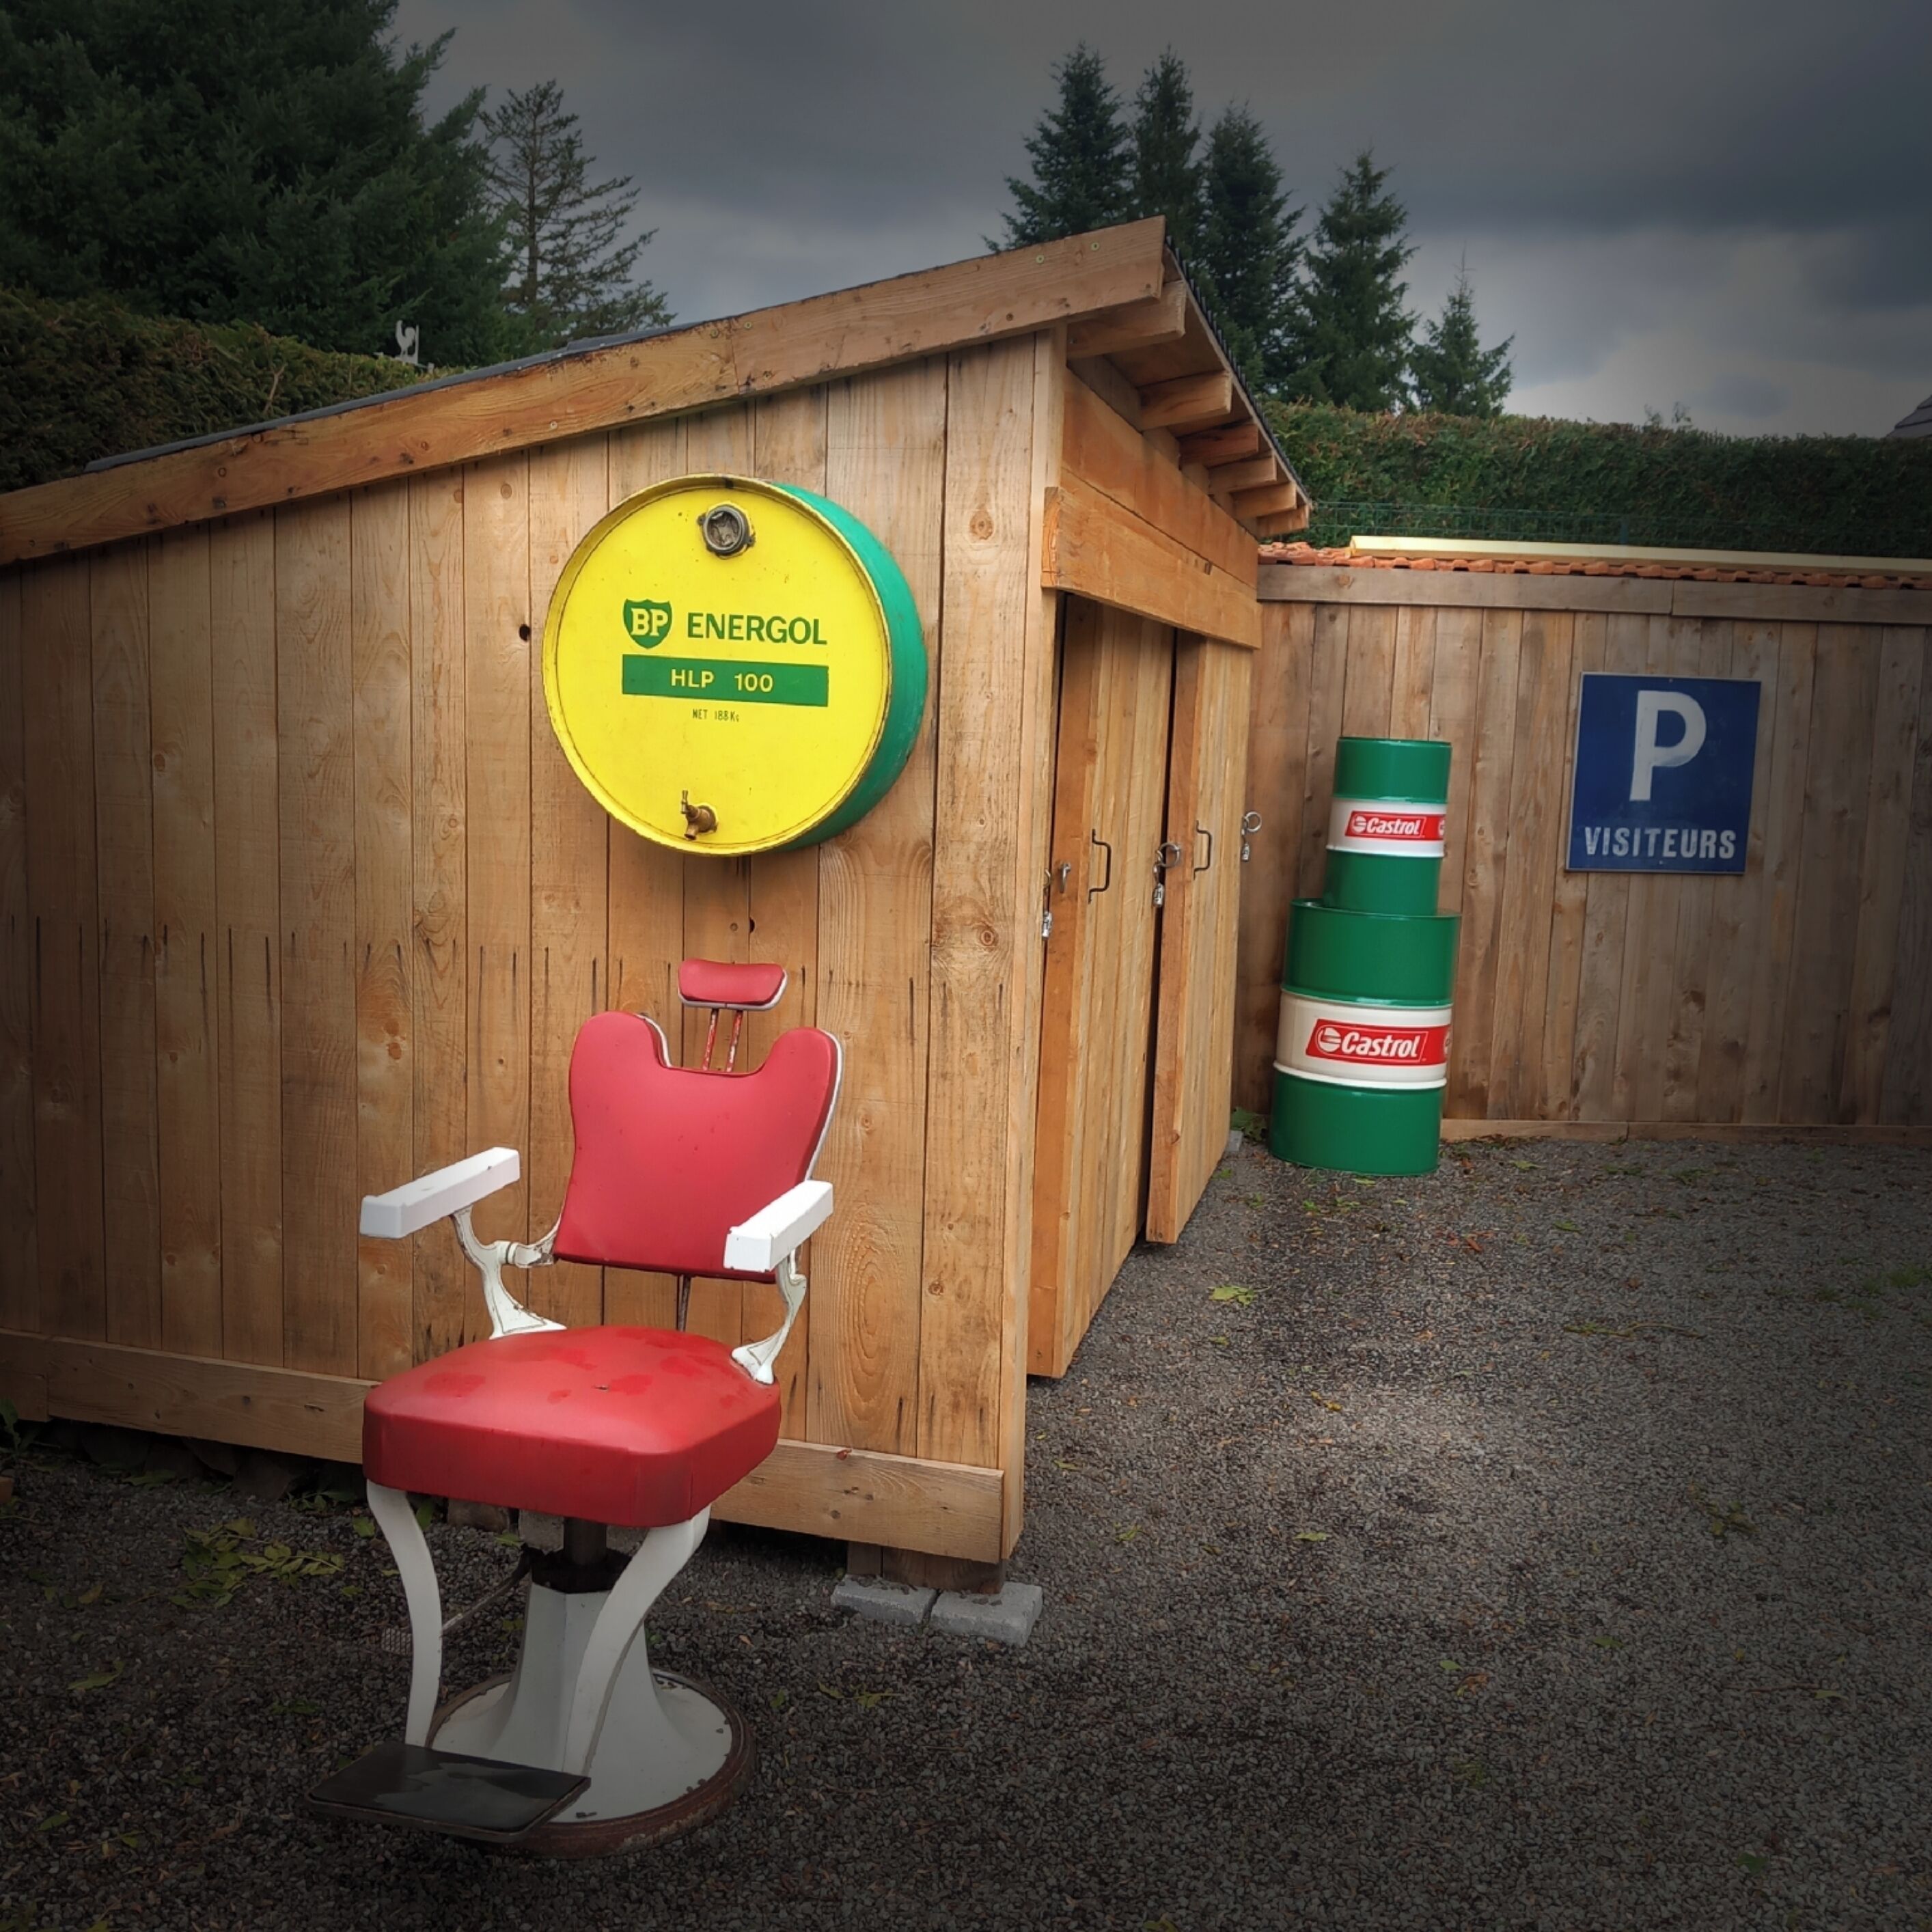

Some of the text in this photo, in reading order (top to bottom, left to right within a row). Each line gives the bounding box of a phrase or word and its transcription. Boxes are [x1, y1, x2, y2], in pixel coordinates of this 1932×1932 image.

[631, 607, 827, 644] BP ENERGOL
[671, 669, 773, 693] HLP 100
[692, 708, 708, 719] NET
[1629, 690, 1706, 801] P
[1367, 817, 1421, 835] Castrol
[1584, 827, 1737, 859] VISITEURS
[1341, 1032, 1420, 1058] Castrol
